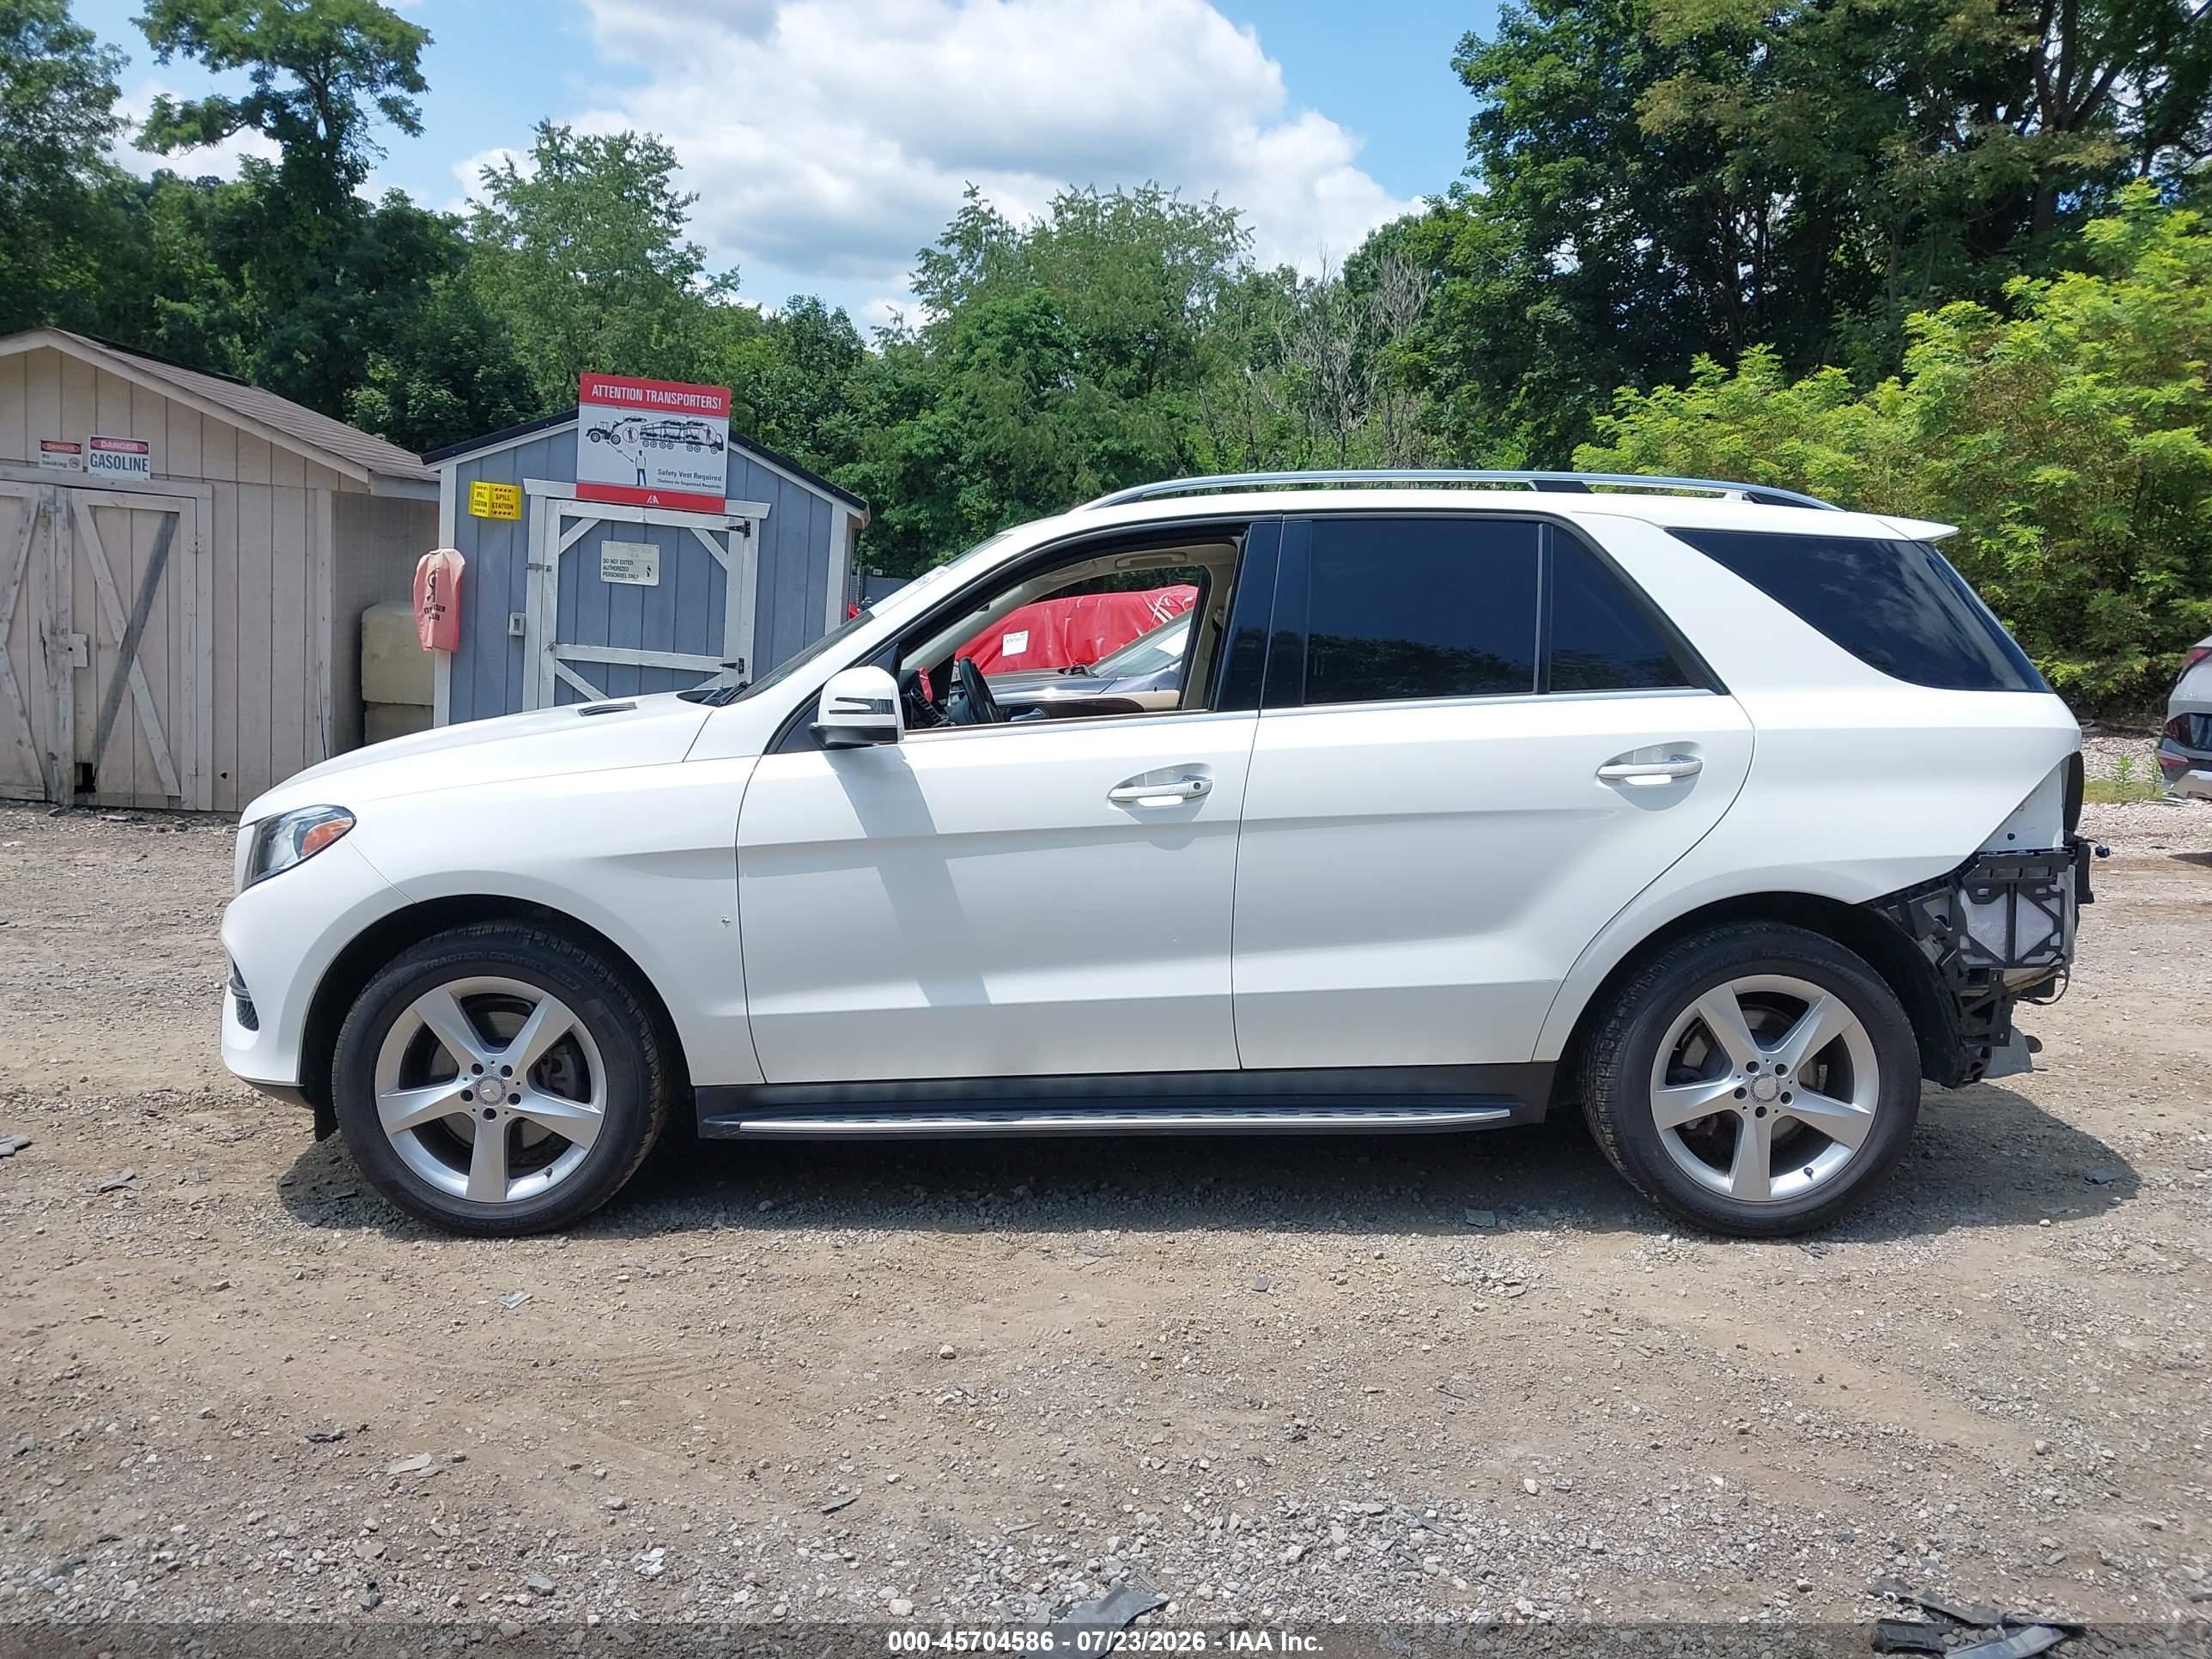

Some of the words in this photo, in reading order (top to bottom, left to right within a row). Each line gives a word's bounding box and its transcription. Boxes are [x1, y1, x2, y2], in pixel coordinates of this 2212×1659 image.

[592, 384, 643, 401] ATTENTION
[646, 389, 722, 410] TRANSPORTERS!
[101, 441, 138, 451] DANGER
[90, 453, 149, 472] GASOLINE
[658, 469, 677, 478] Safety
[694, 472, 722, 481] Required
